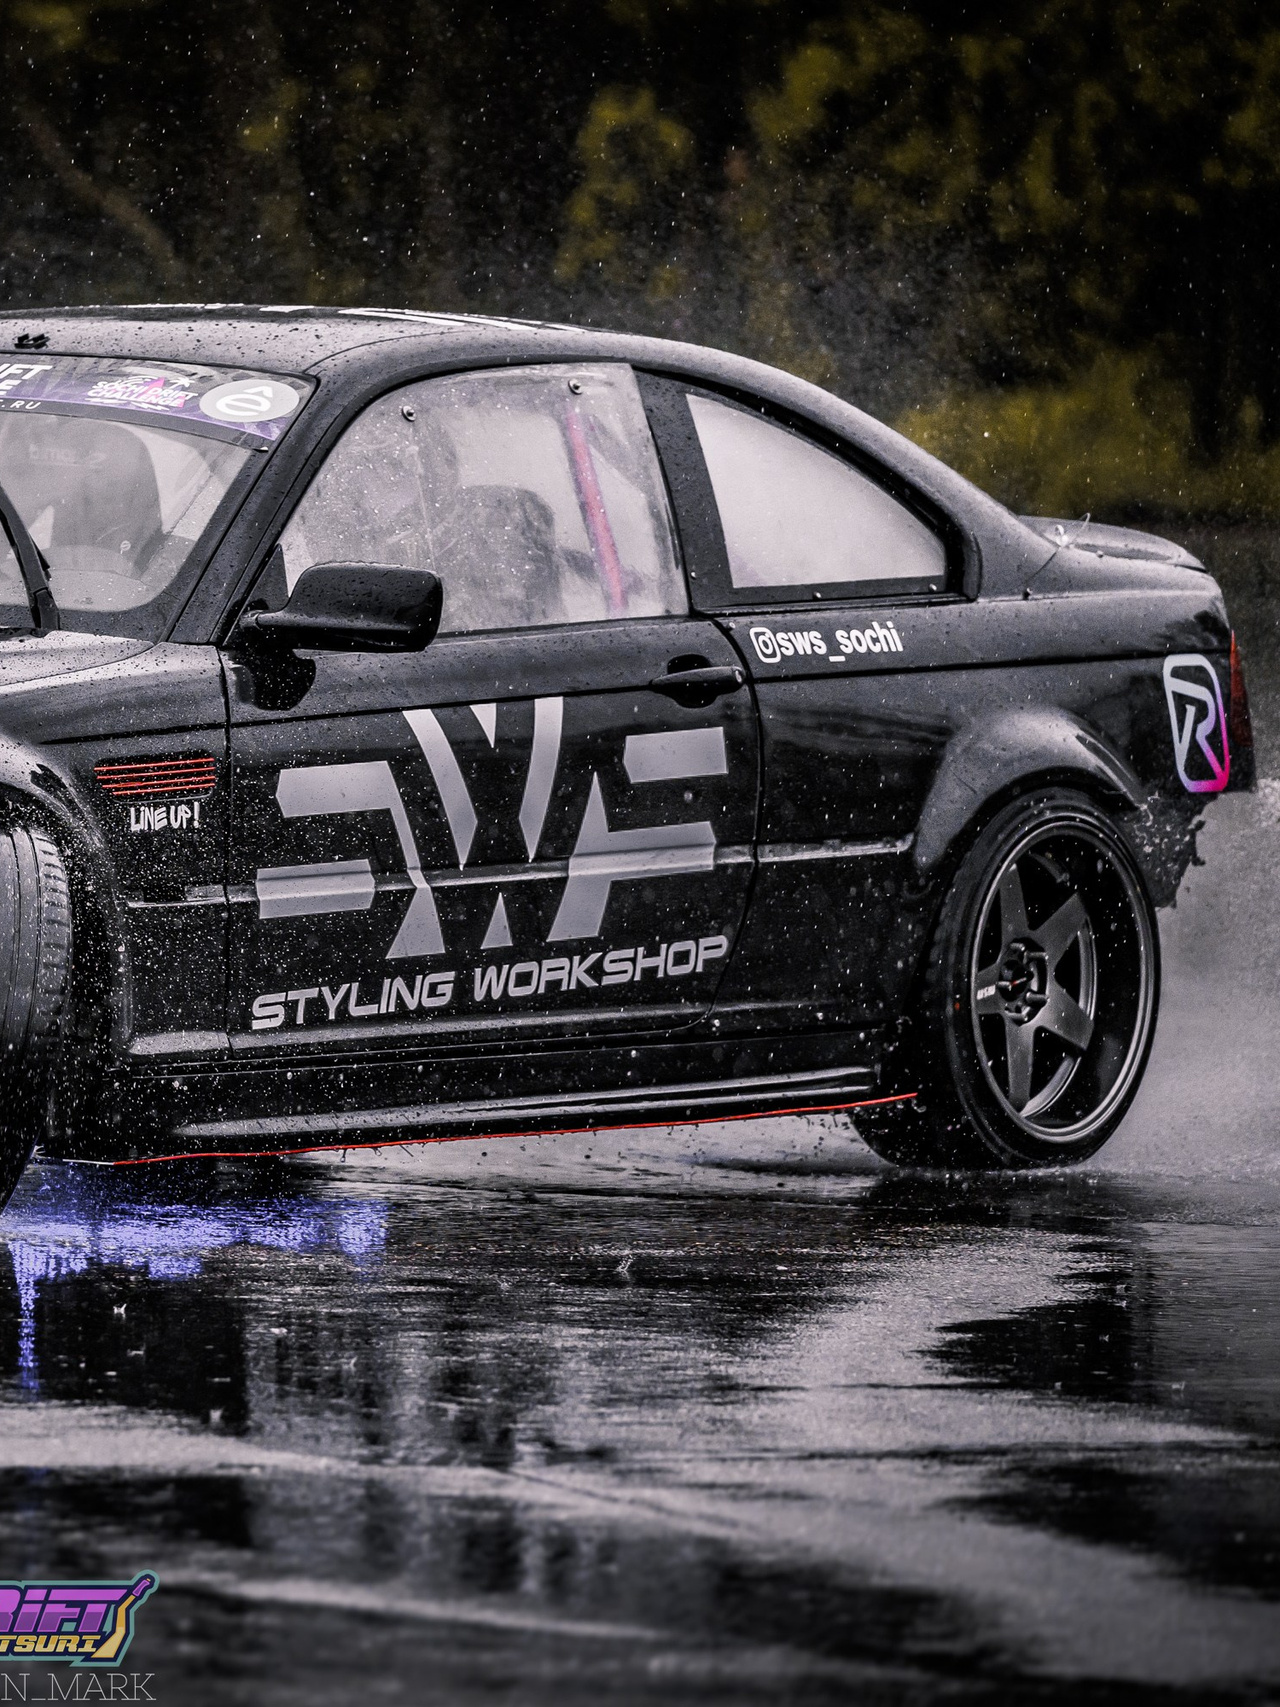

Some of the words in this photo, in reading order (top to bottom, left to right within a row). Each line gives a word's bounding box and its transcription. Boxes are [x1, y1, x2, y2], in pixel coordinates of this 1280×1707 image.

[87, 388, 183, 408] CHALLENGE
[92, 381, 148, 395] SOCHI
[147, 387, 198, 401] DRIFT
[251, 971, 456, 1031] STYLING
[474, 935, 729, 1001] WORKSHOP
